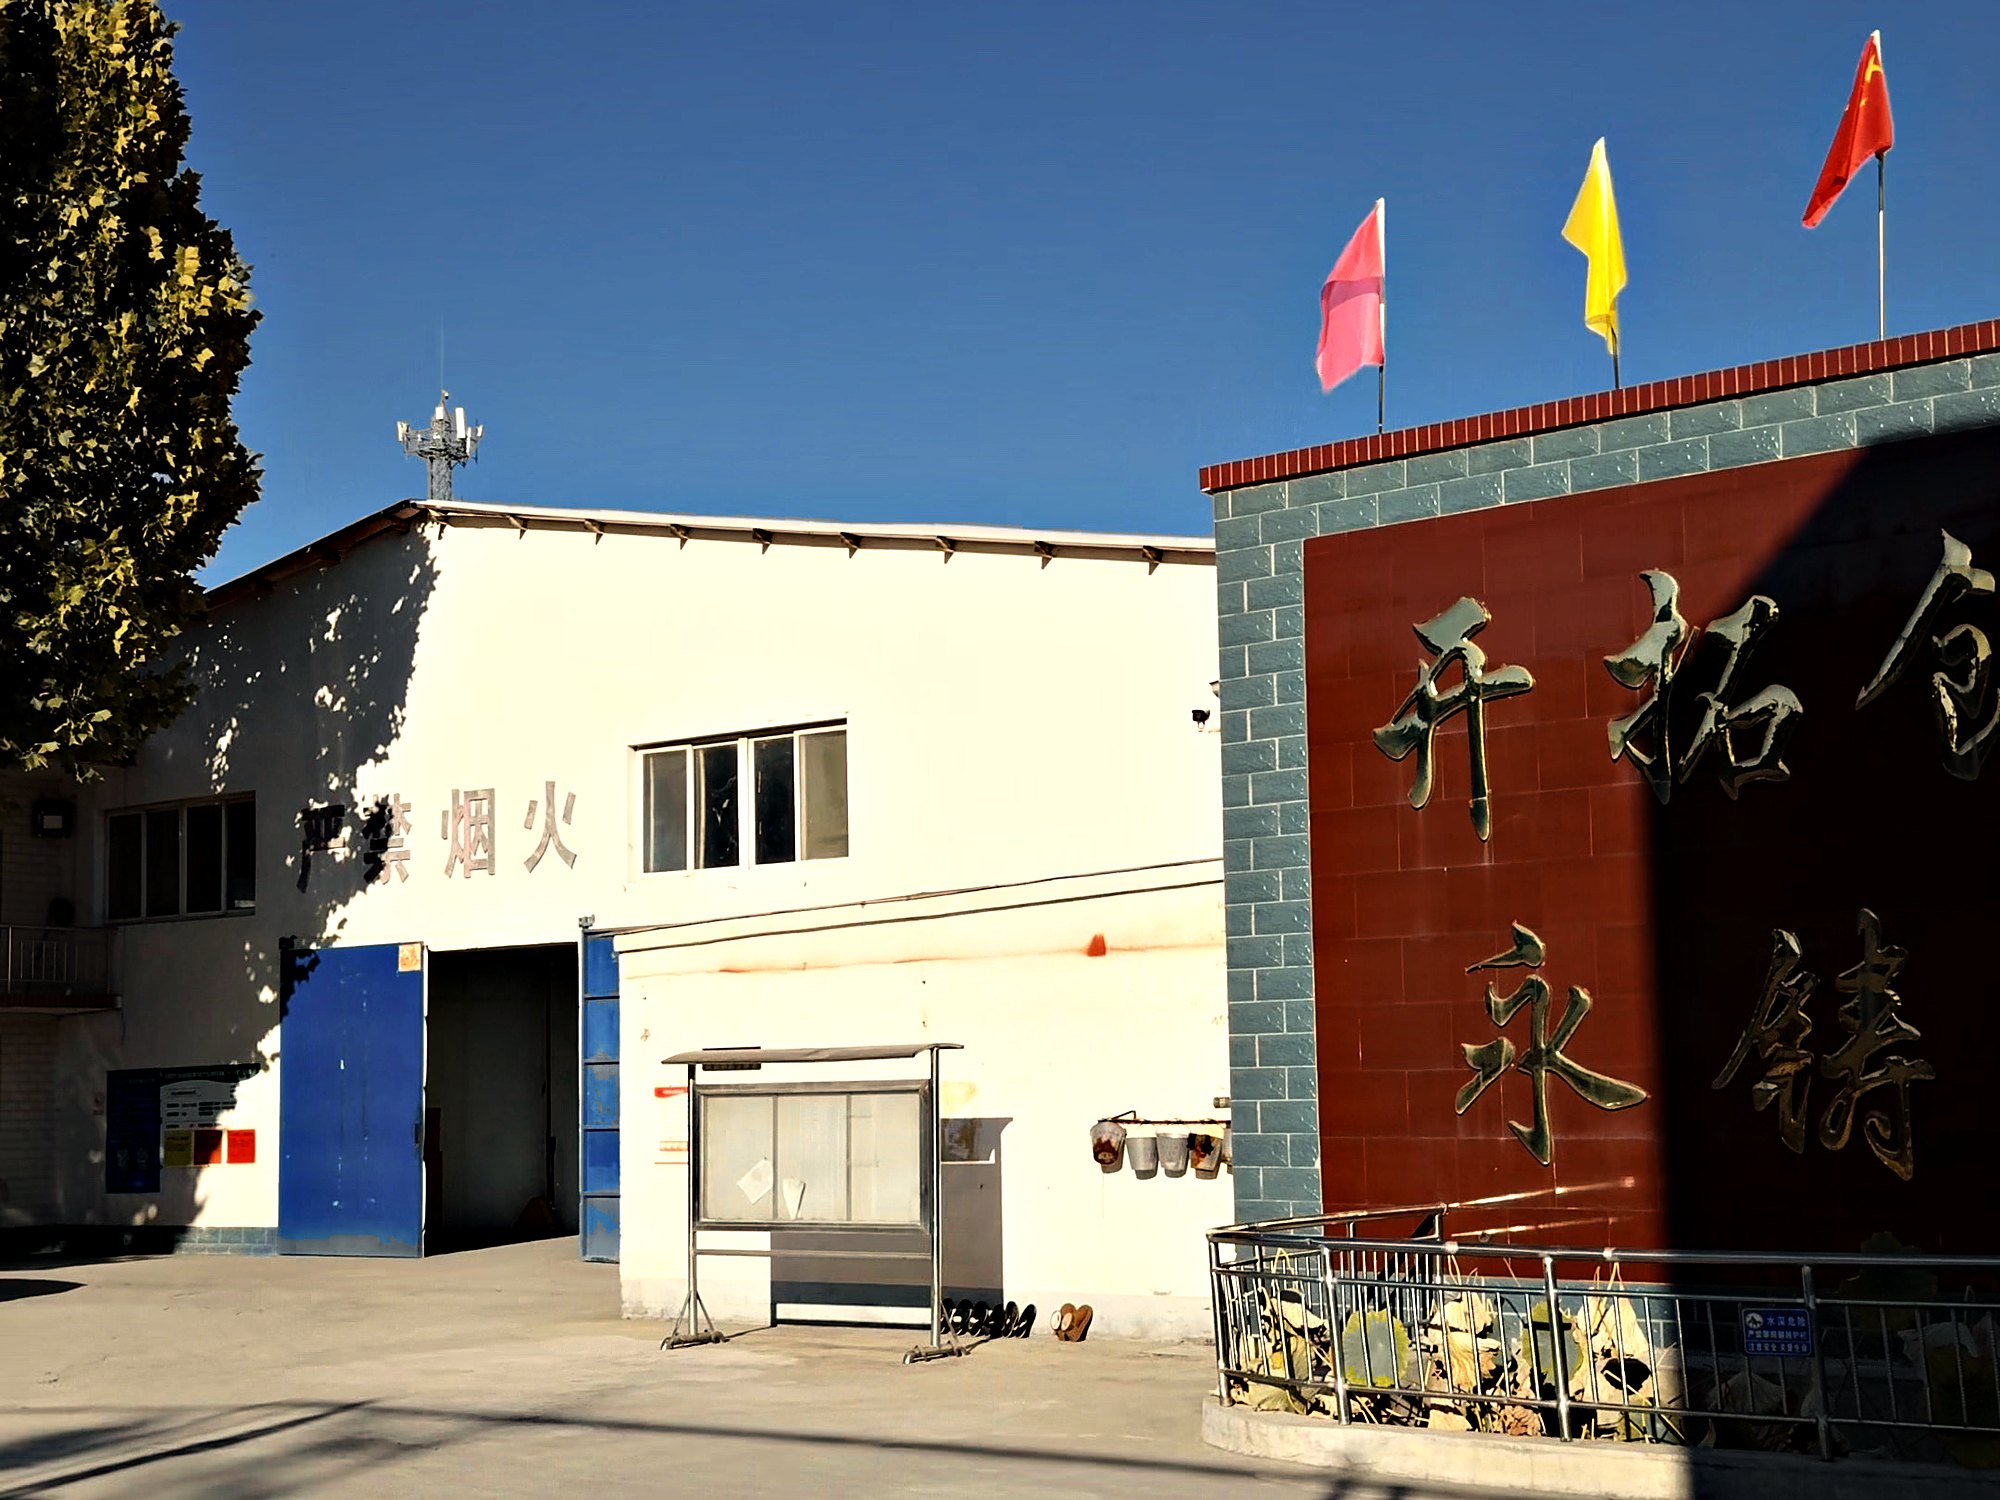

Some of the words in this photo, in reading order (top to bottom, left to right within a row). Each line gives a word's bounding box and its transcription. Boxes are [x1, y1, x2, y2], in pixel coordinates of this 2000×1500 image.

[296, 781, 577, 894] 严禁烟火
[1454, 908, 1937, 1182] 永铸
[1767, 1316, 1806, 1327] 水深危险
